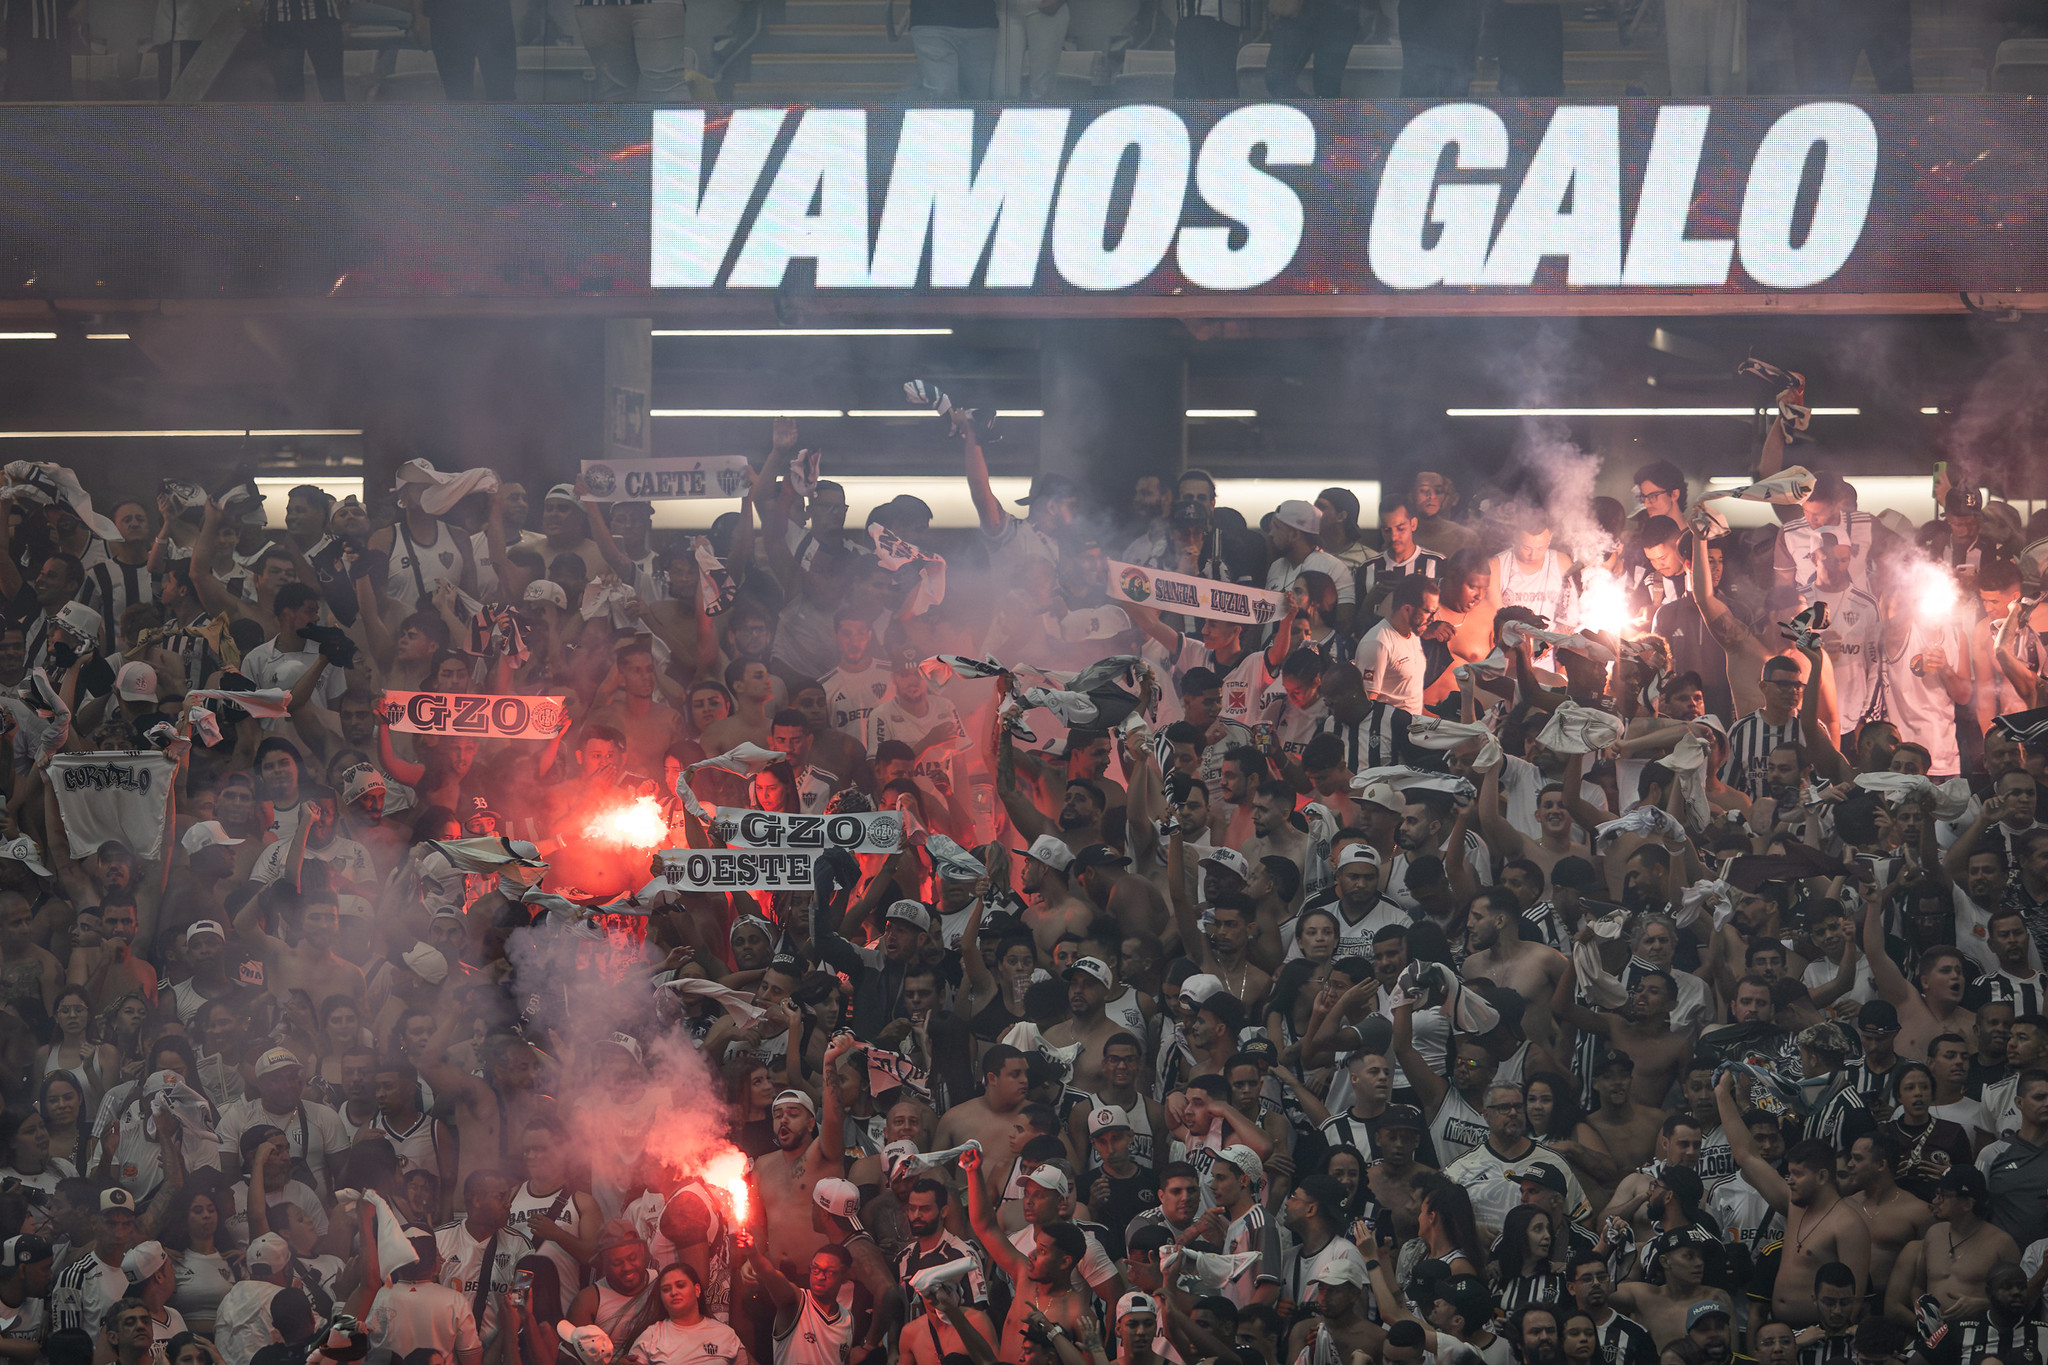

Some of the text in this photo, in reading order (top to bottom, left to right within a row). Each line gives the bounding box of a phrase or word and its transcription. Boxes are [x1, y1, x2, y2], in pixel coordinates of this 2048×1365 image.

[650, 102, 1879, 290] VAMOS GALO
[625, 461, 706, 497] CAETÉ
[1155, 577, 1250, 617] SANTA LUZIA
[407, 695, 531, 735] GZO
[65, 762, 153, 796] CURVELO
[740, 812, 866, 848] GZO
[687, 854, 812, 887] OESTE
[1692, 1303, 1714, 1316] Hurley
